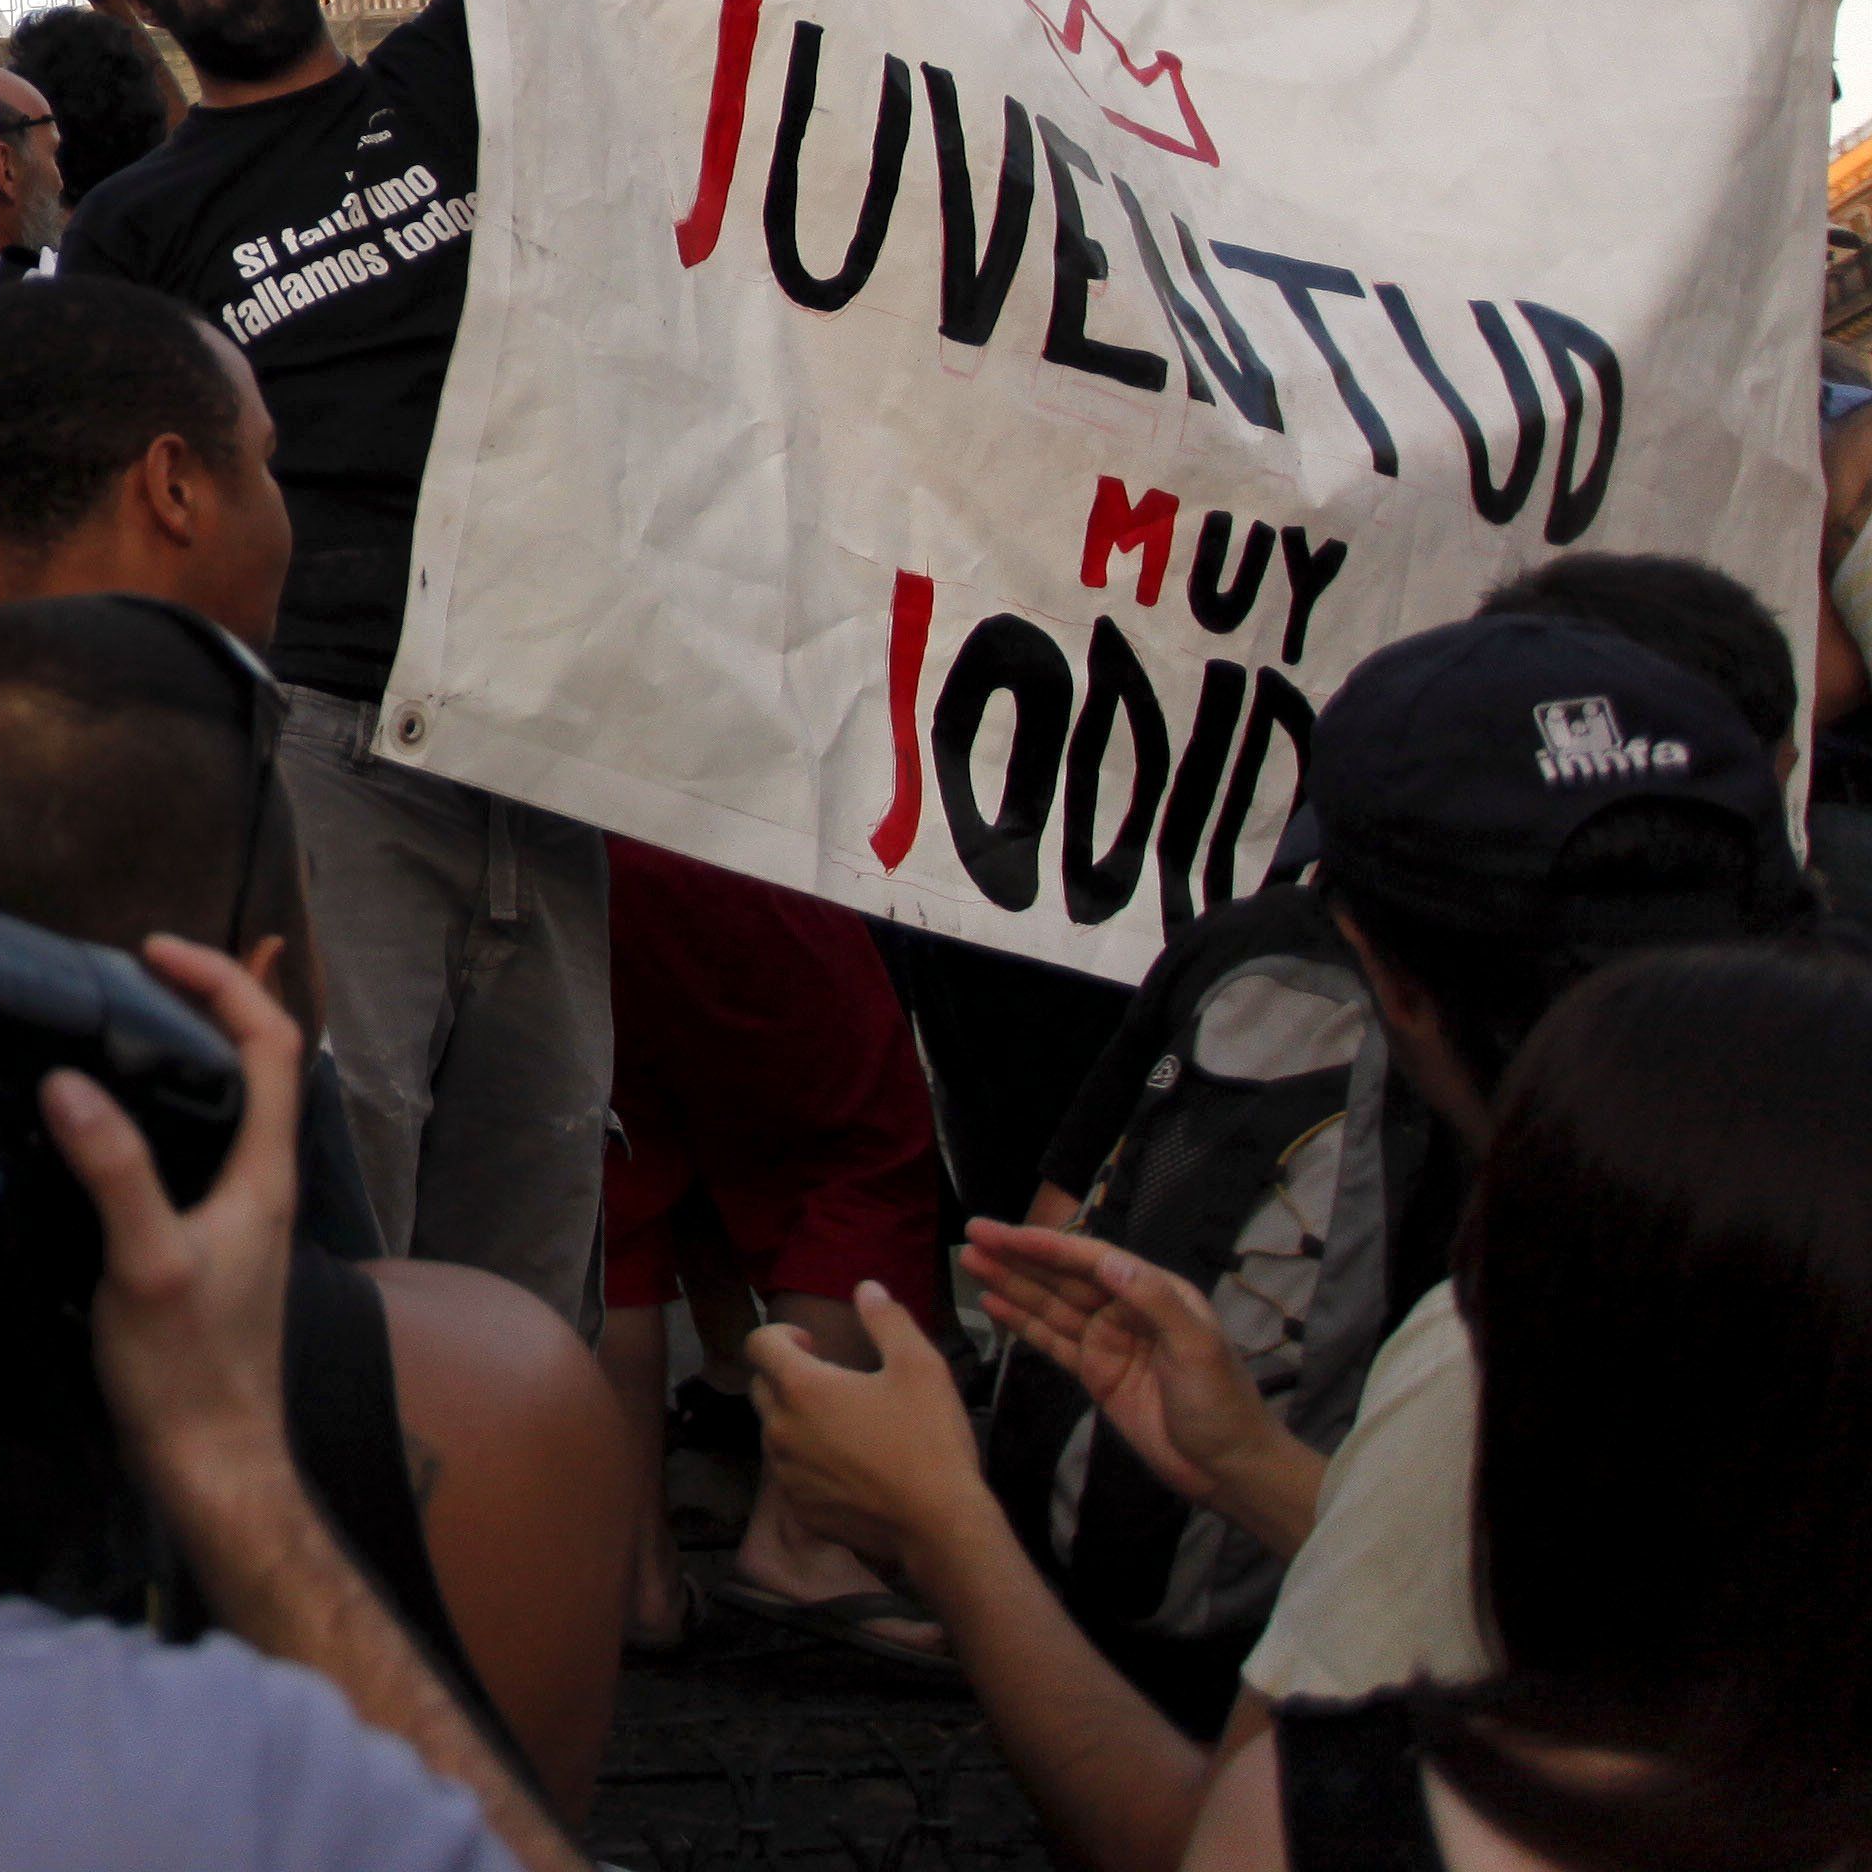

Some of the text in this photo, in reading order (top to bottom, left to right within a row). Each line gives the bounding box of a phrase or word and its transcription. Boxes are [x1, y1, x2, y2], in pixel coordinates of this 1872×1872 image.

[221, 241, 391, 346] fallamos
[232, 235, 278, 280] Si
[363, 163, 440, 221] uno
[1079, 474, 1349, 665] MUY
[868, 566, 1320, 946] JODID
